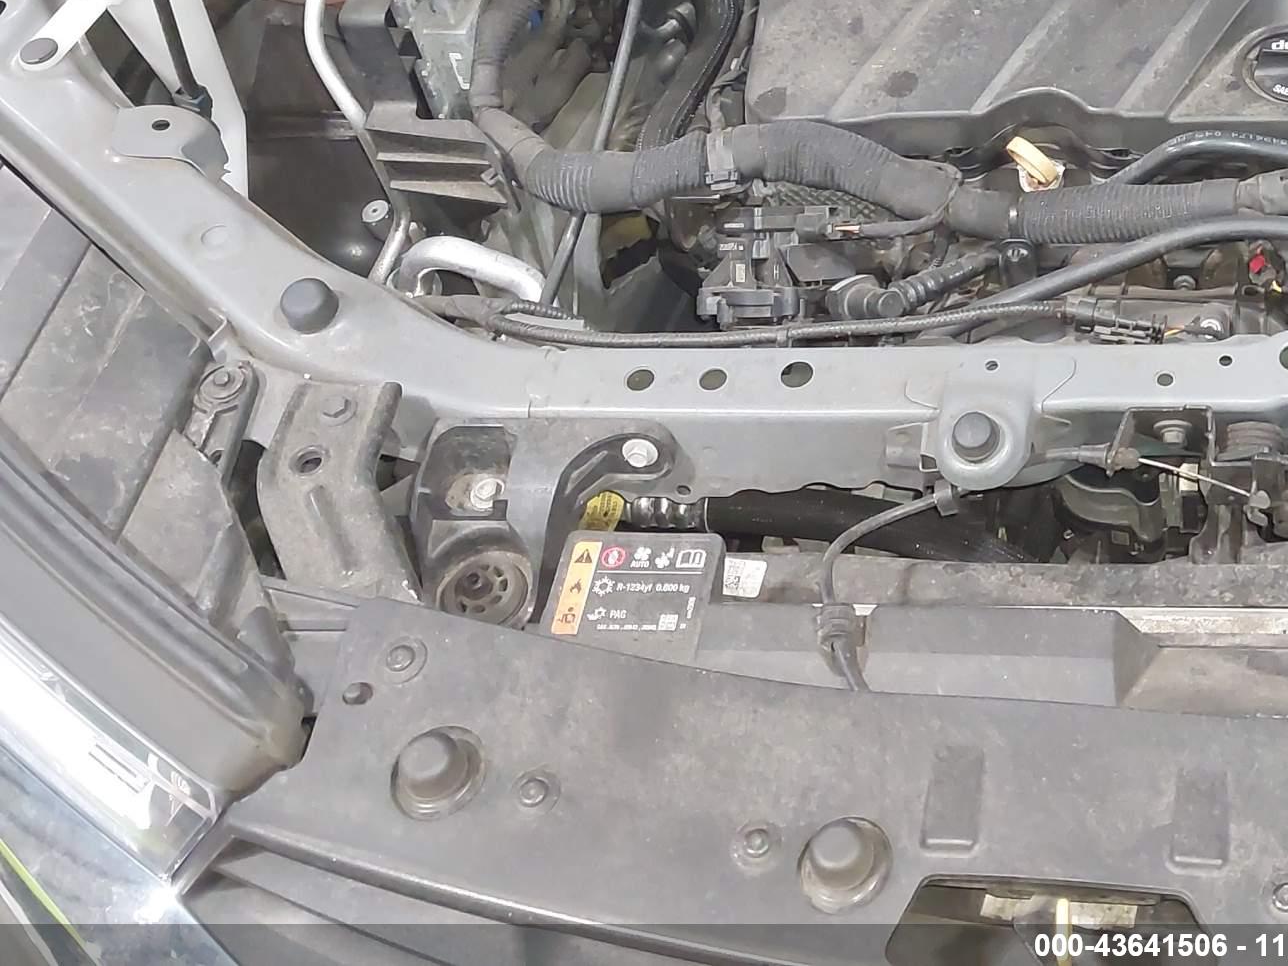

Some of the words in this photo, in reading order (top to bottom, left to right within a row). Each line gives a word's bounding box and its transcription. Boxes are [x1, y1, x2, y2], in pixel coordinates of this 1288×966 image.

[630, 560, 650, 568] AUTO
[616, 581, 653, 593] R-1234yf
[679, 583, 691, 594] kg
[609, 610, 627, 619] PAG
